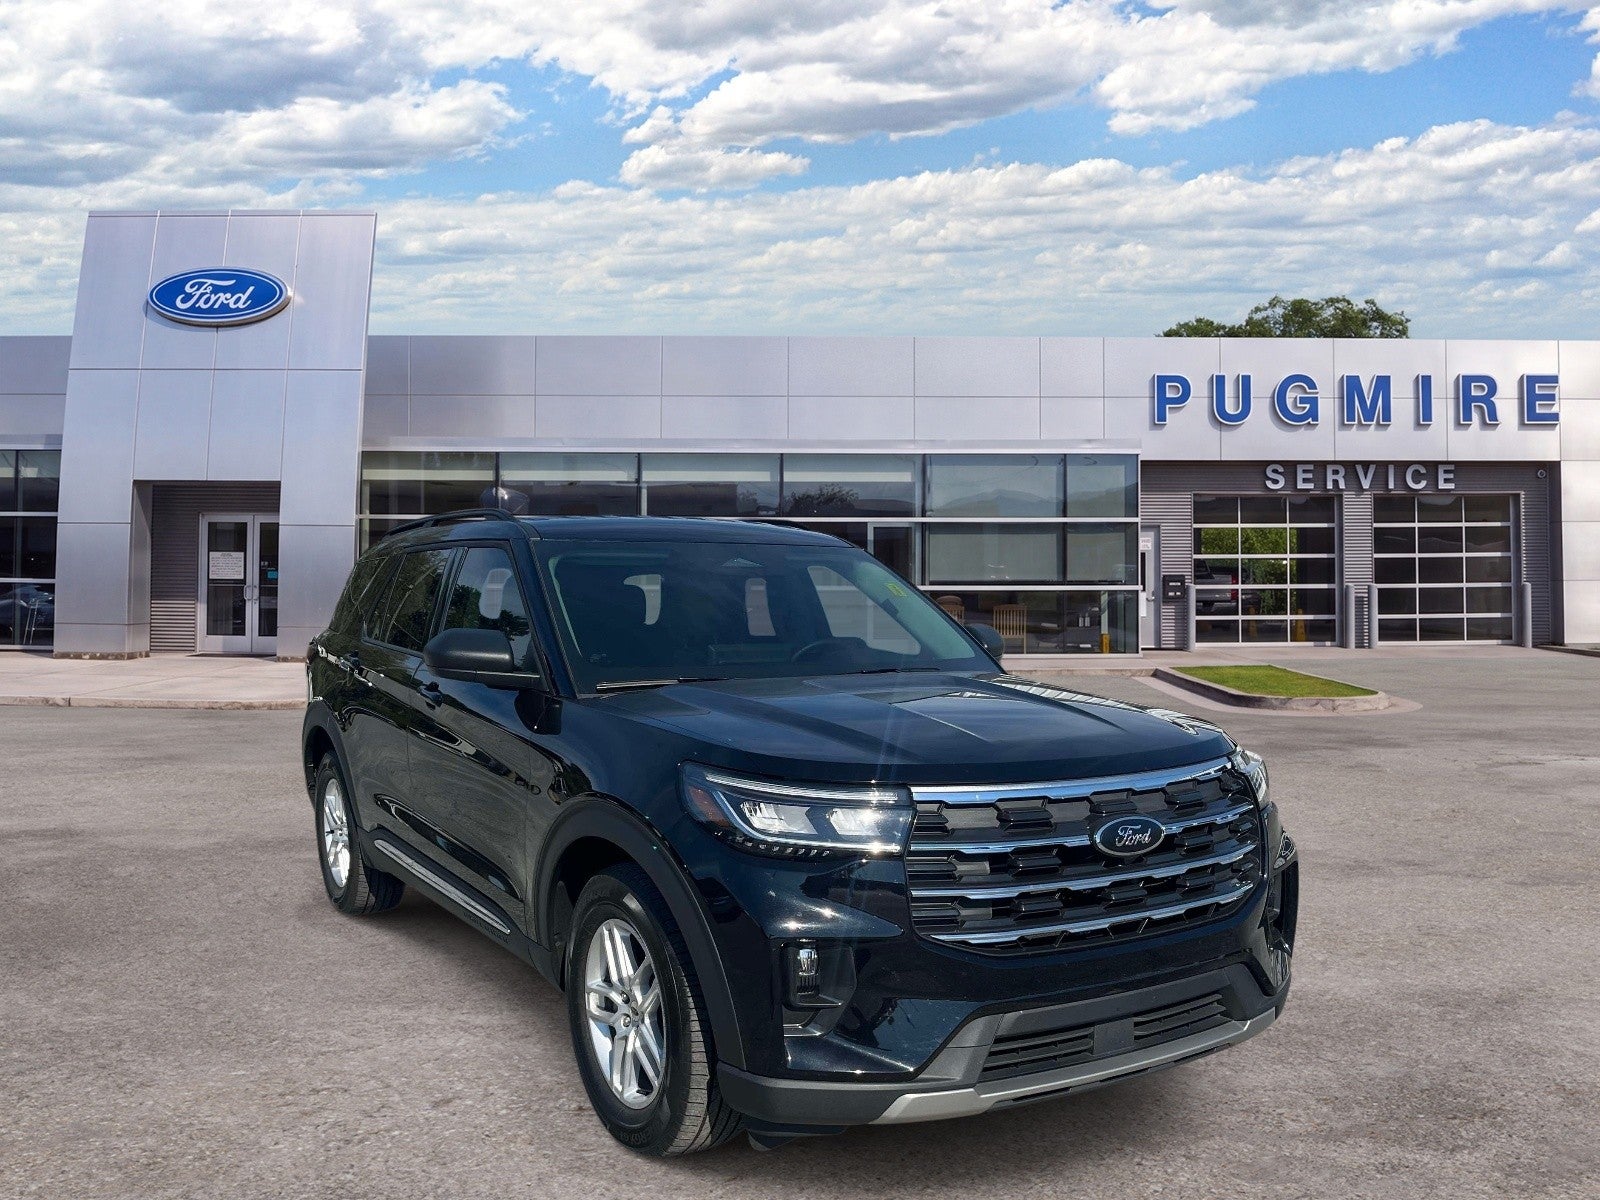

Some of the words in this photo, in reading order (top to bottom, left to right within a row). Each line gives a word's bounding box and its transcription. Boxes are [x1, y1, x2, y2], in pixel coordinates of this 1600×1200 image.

[175, 278, 256, 310] Ford
[1153, 373, 1560, 426] PUGMIRE
[1265, 463, 1456, 490] SERVICE
[1115, 824, 1152, 847] Ford
